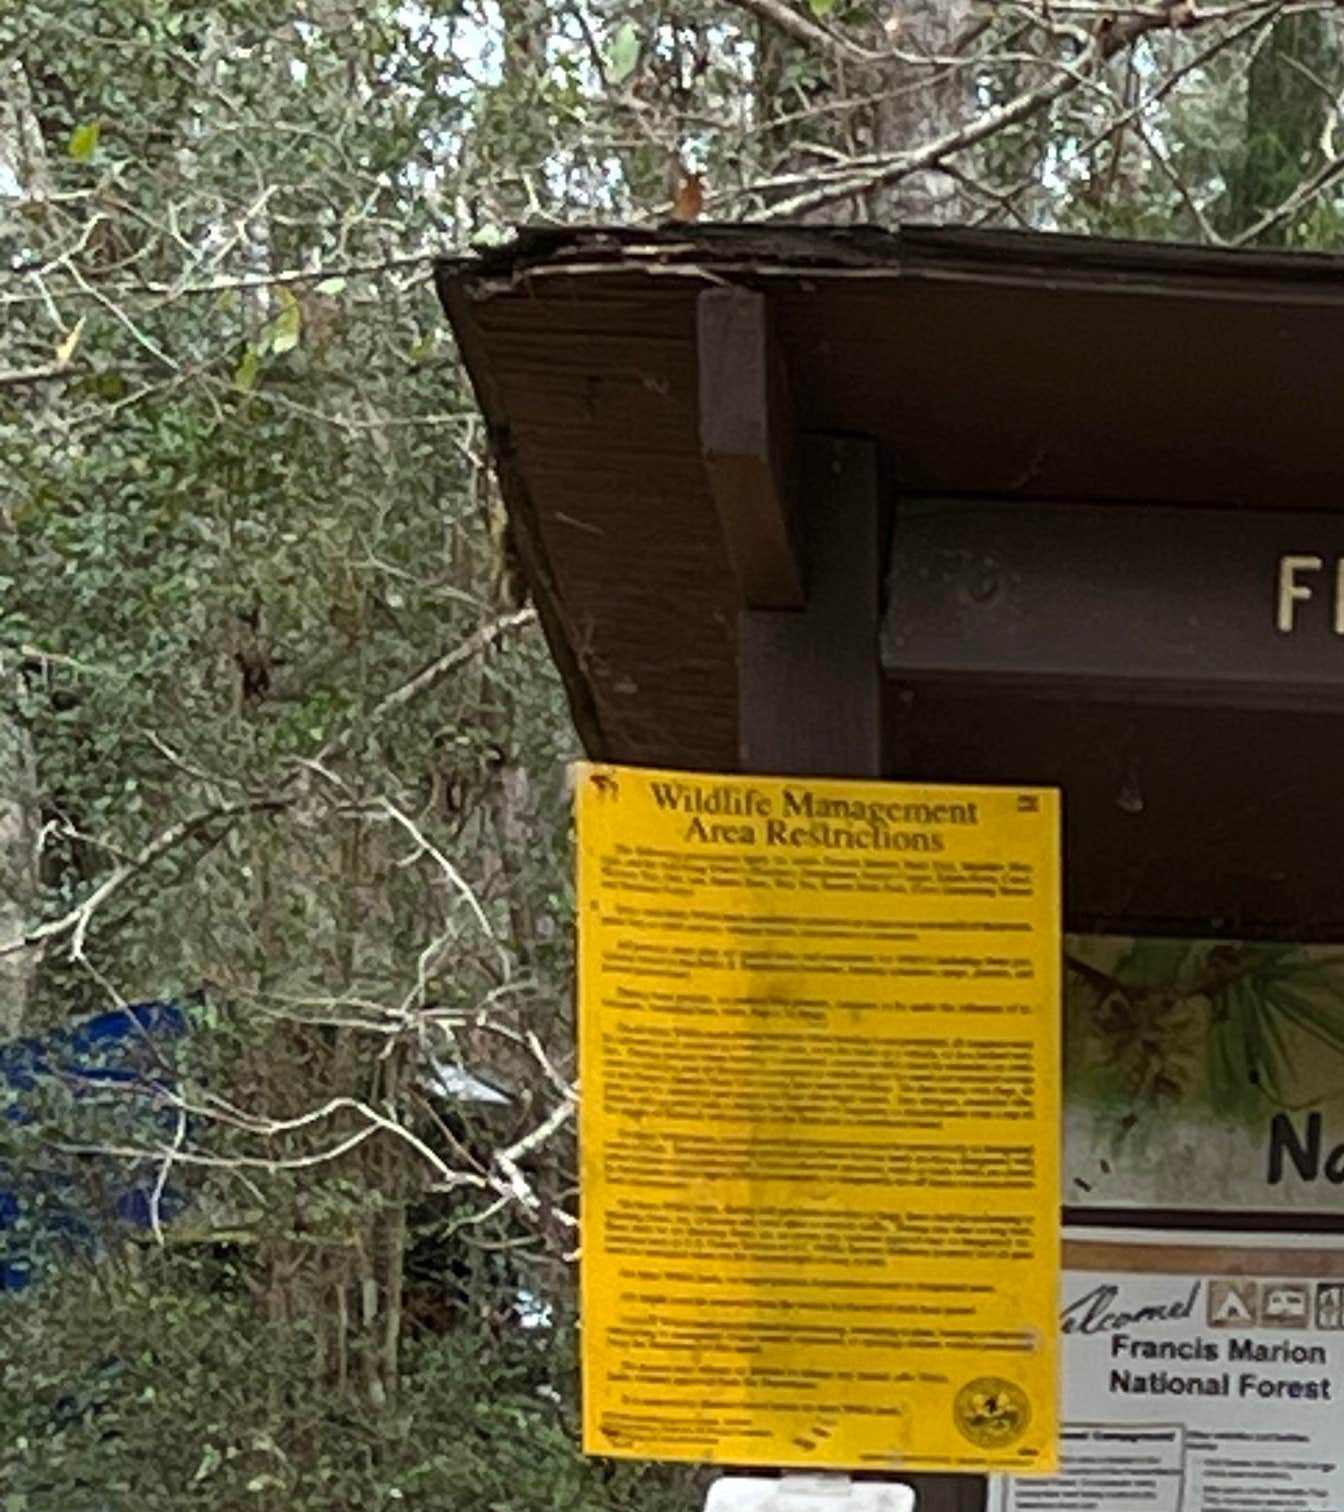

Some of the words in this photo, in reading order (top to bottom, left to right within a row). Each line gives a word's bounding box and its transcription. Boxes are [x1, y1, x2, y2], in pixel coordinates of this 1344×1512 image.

[652, 783, 773, 817] Wildlife
[782, 792, 978, 831] Management
[683, 818, 755, 845] Area
[767, 818, 944, 851] Restrictions
[1059, 1279, 1201, 1334] elcome!
[1111, 1334, 1218, 1362] Francis
[1228, 1338, 1326, 1364] Marion
[1109, 1370, 1228, 1396] National
[1239, 1374, 1332, 1400] Forest
